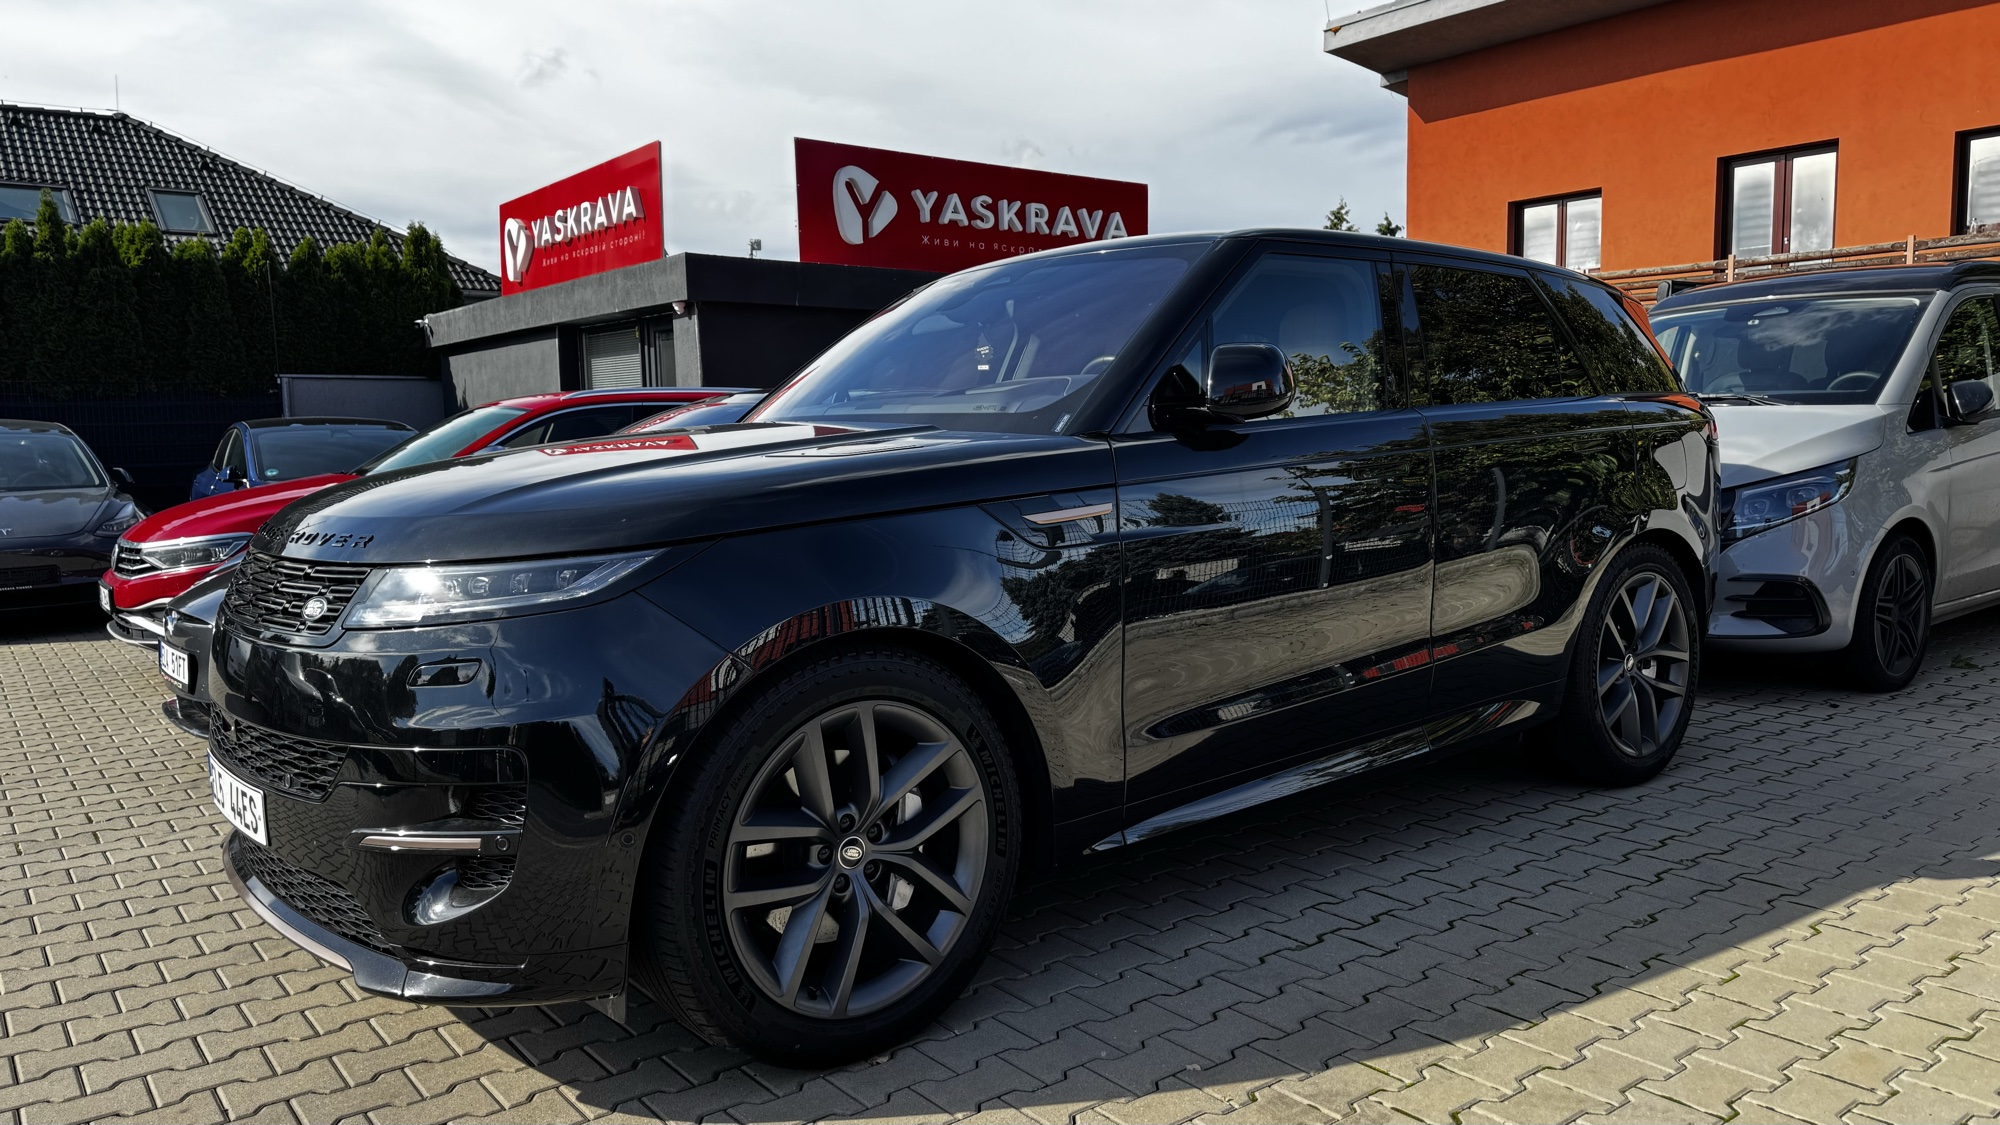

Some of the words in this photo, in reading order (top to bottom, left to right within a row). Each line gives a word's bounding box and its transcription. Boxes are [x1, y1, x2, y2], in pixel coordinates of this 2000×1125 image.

[531, 185, 641, 248] YASKRAVA
[911, 188, 1129, 240] YASKRAVA
[921, 234, 959, 247] Живи
[969, 241, 985, 250] на
[993, 242, 1044, 255] яскра
[229, 781, 259, 835] 44ES
[708, 790, 732, 849] PRIMACY
[979, 749, 1007, 852] MICHELIN
[704, 867, 740, 985] MICHELIN
